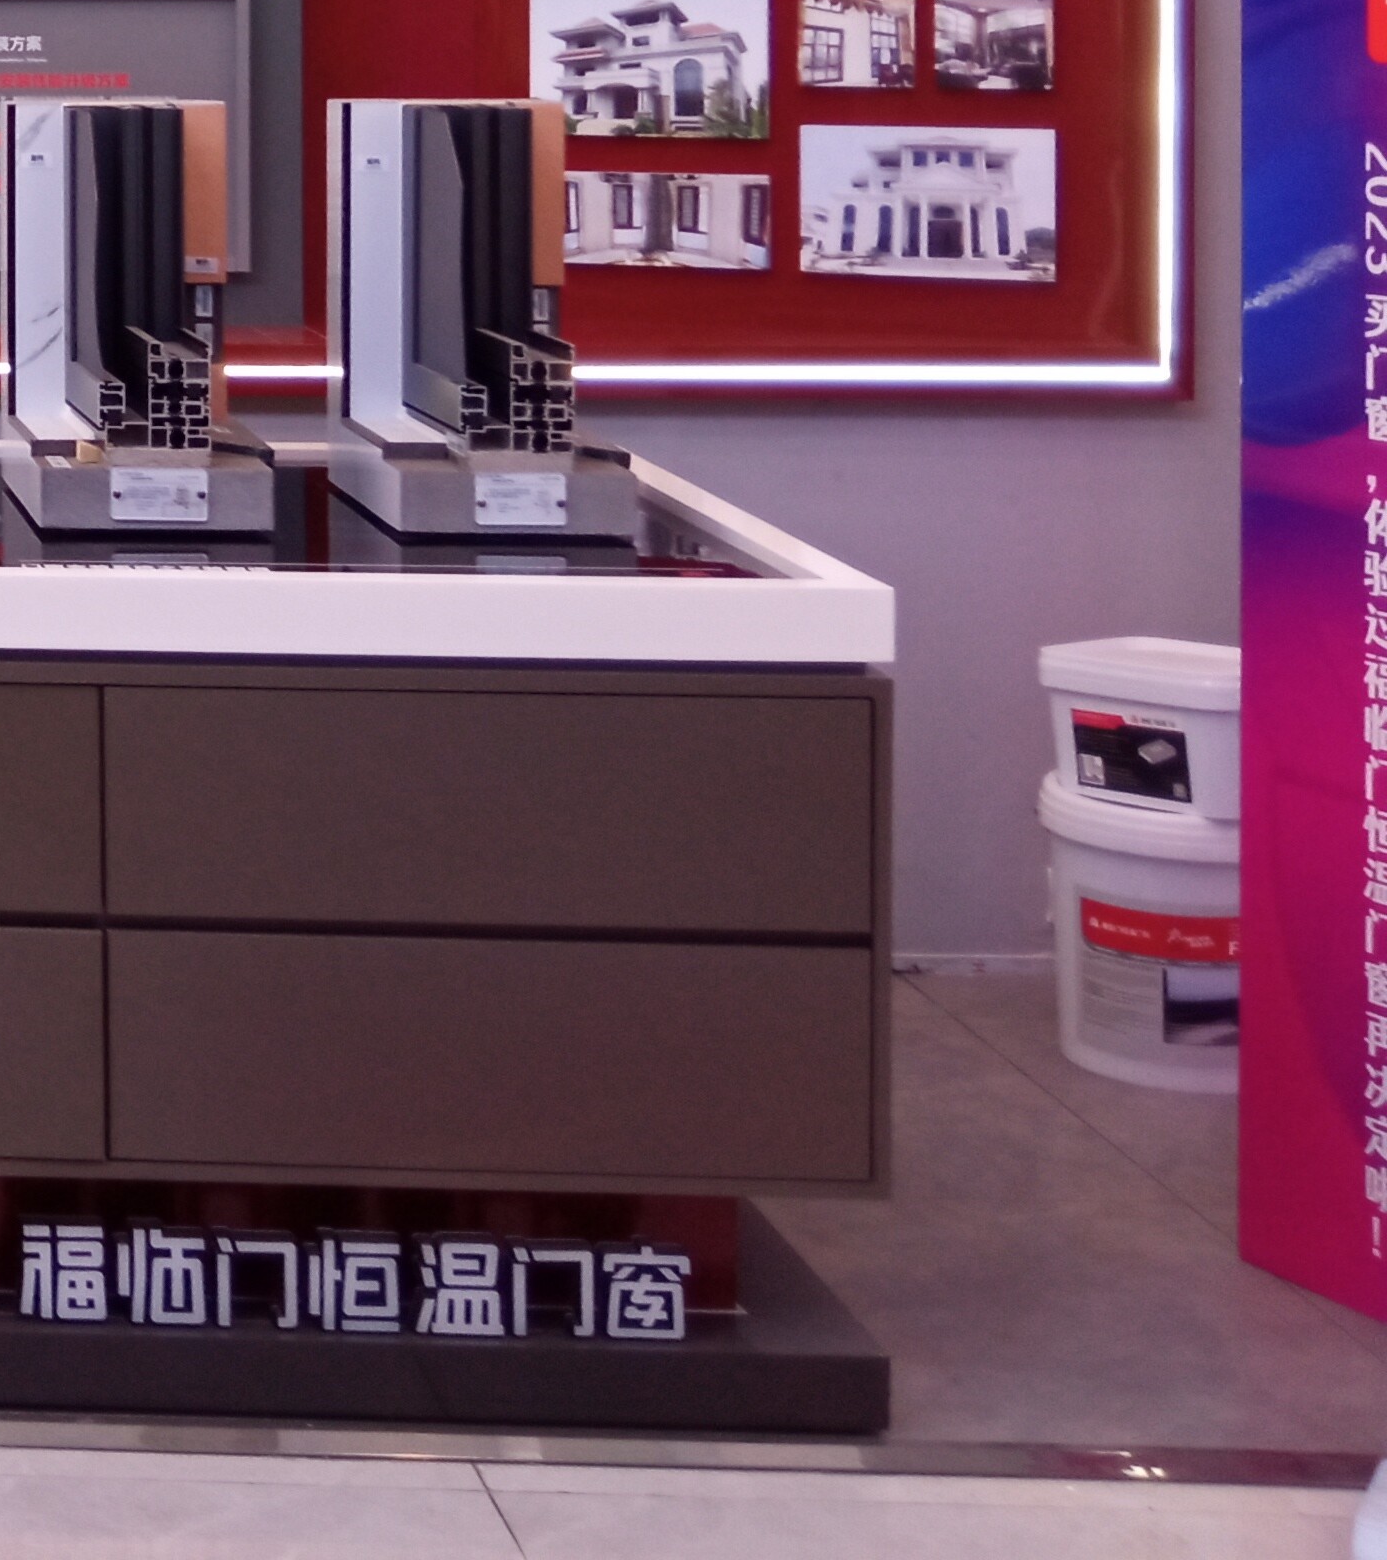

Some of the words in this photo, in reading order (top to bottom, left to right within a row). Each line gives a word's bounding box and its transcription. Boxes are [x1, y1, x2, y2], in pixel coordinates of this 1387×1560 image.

[19, 1222, 692, 1341] 福临门恒温门窗
